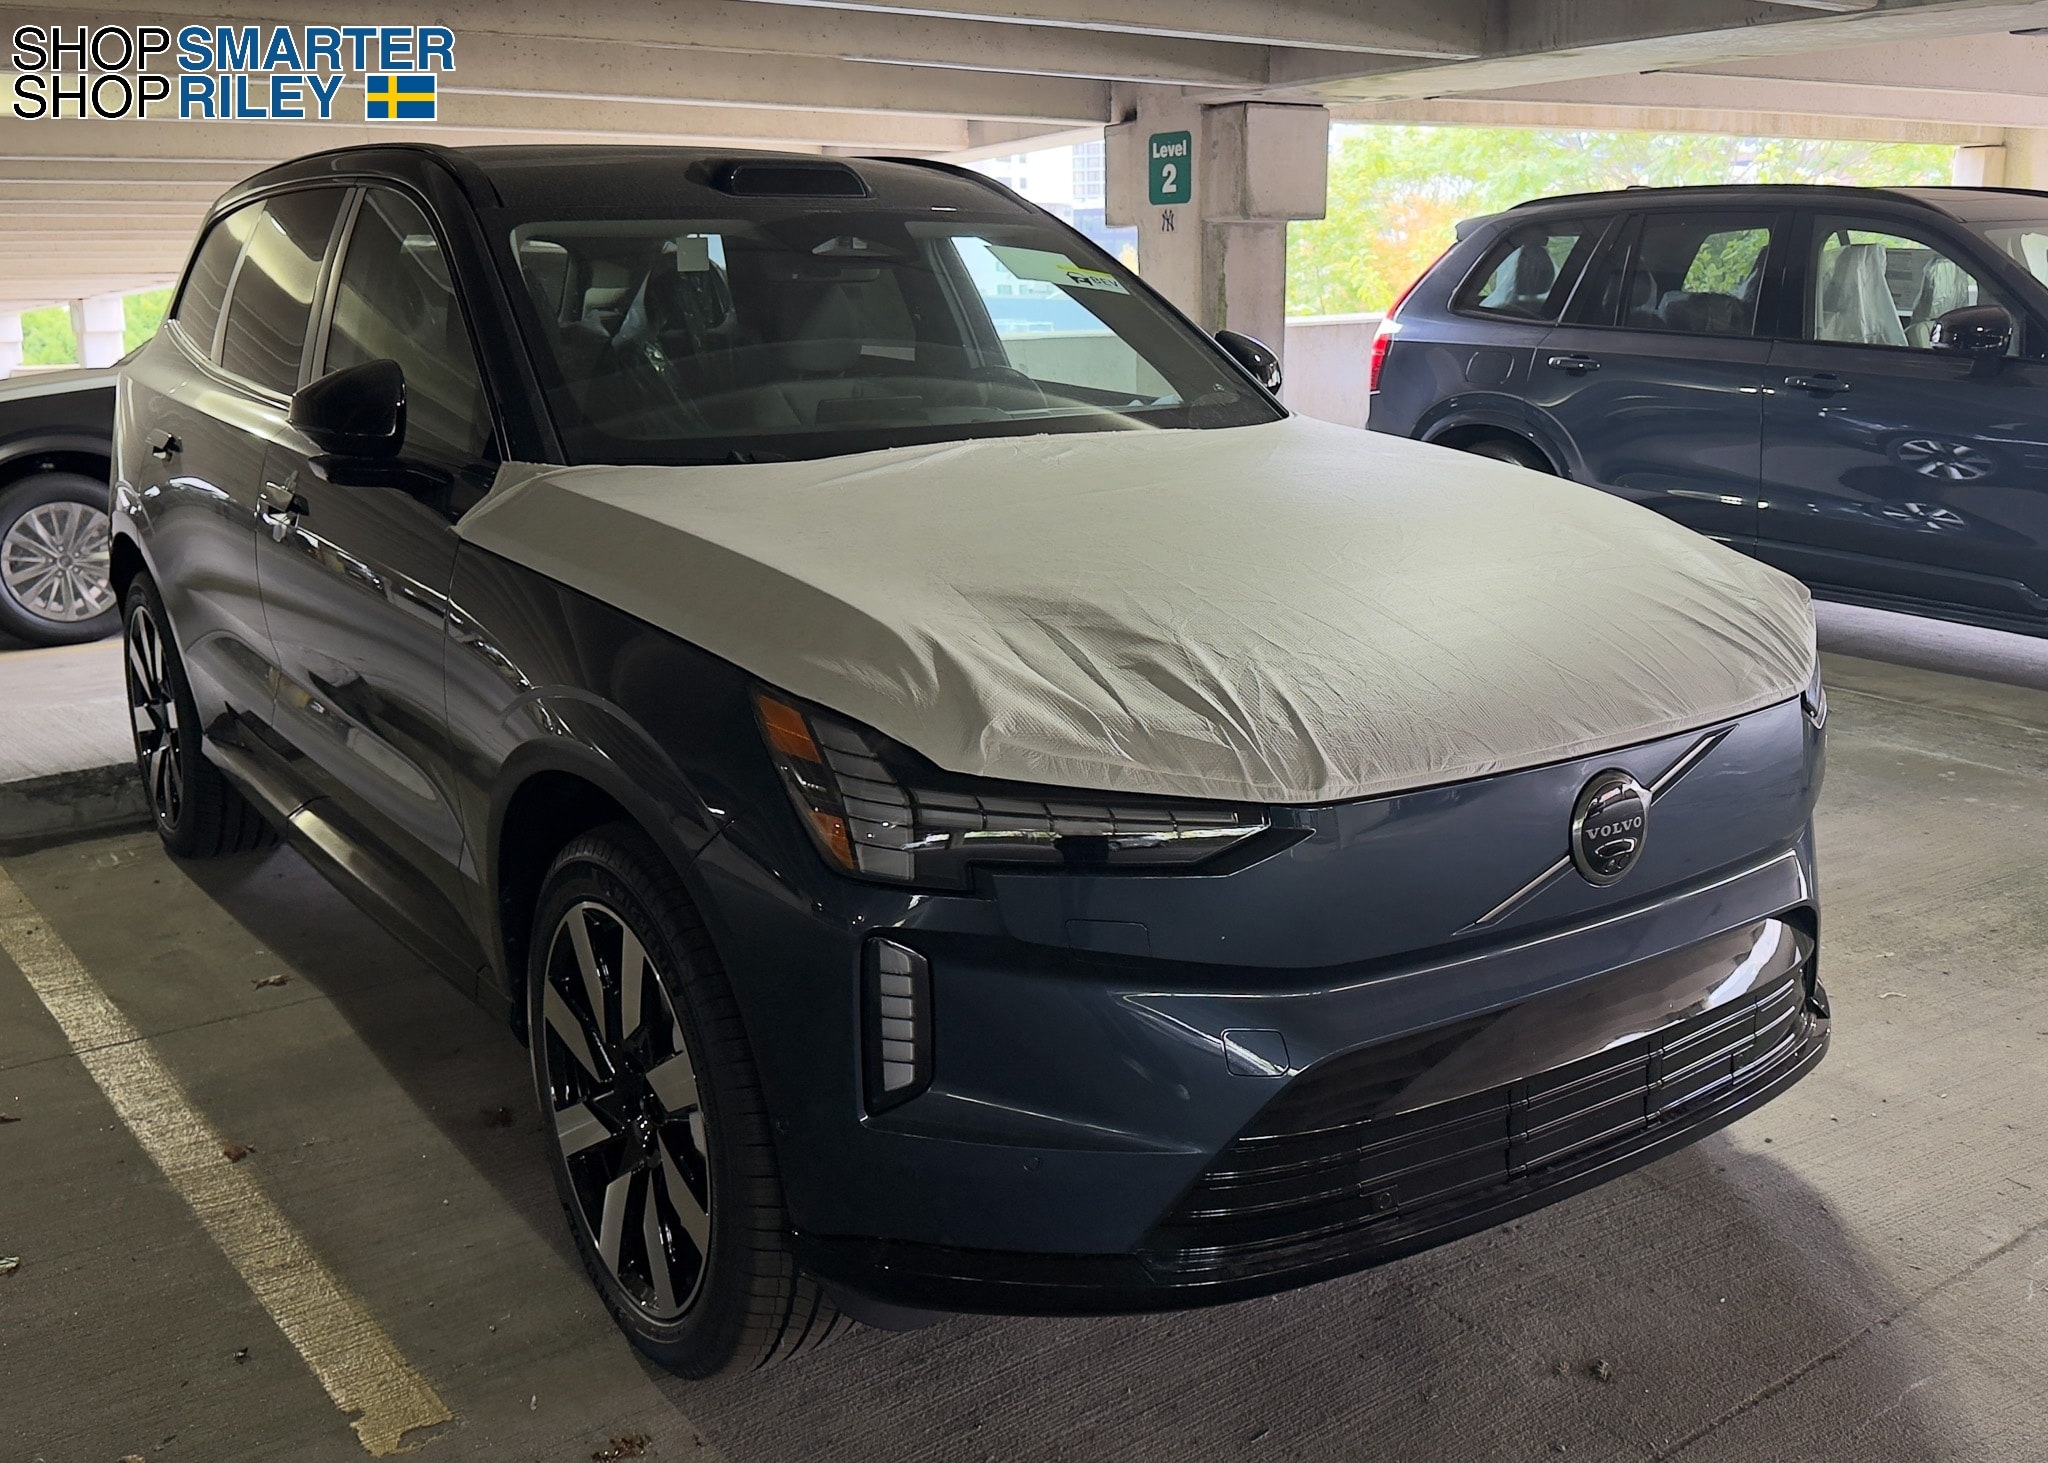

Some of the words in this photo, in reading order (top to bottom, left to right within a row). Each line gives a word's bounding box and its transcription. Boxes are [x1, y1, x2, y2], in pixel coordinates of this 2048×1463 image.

[1152, 140, 1187, 159] Level
[1161, 163, 1177, 194] 2
[1585, 816, 1642, 840] VOLVO
